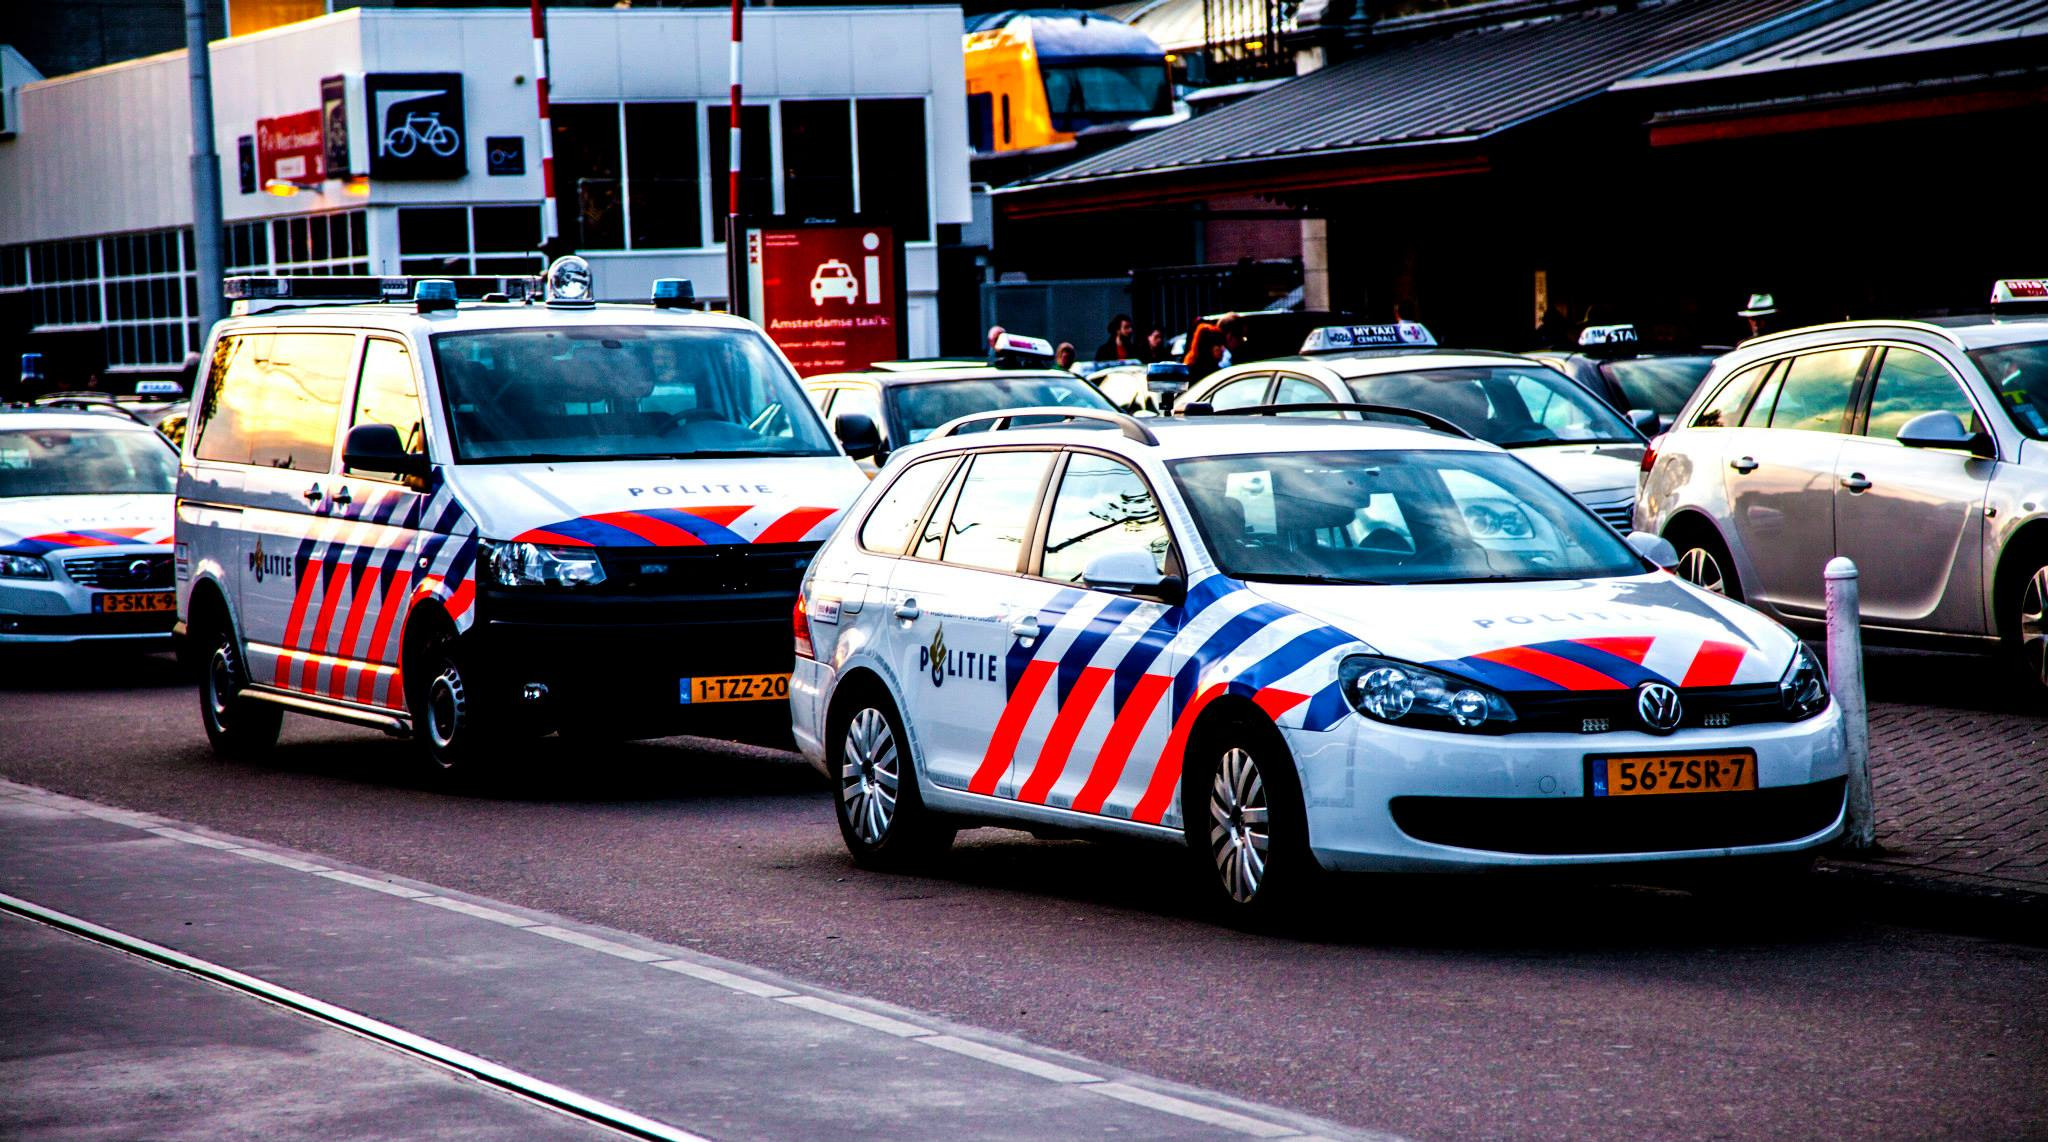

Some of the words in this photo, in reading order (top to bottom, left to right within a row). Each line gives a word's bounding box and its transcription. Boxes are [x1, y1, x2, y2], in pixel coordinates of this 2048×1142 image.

[771, 317, 853, 328] Amsterdamse
[1353, 327, 1369, 336] MY
[1373, 326, 1394, 335] TAXI
[628, 484, 773, 497] POLITIE
[249, 552, 292, 583] POLITIE
[108, 595, 176, 611] 3-SKK-9
[920, 645, 997, 688] POLITIE
[700, 676, 789, 700] 1-TZZ-20
